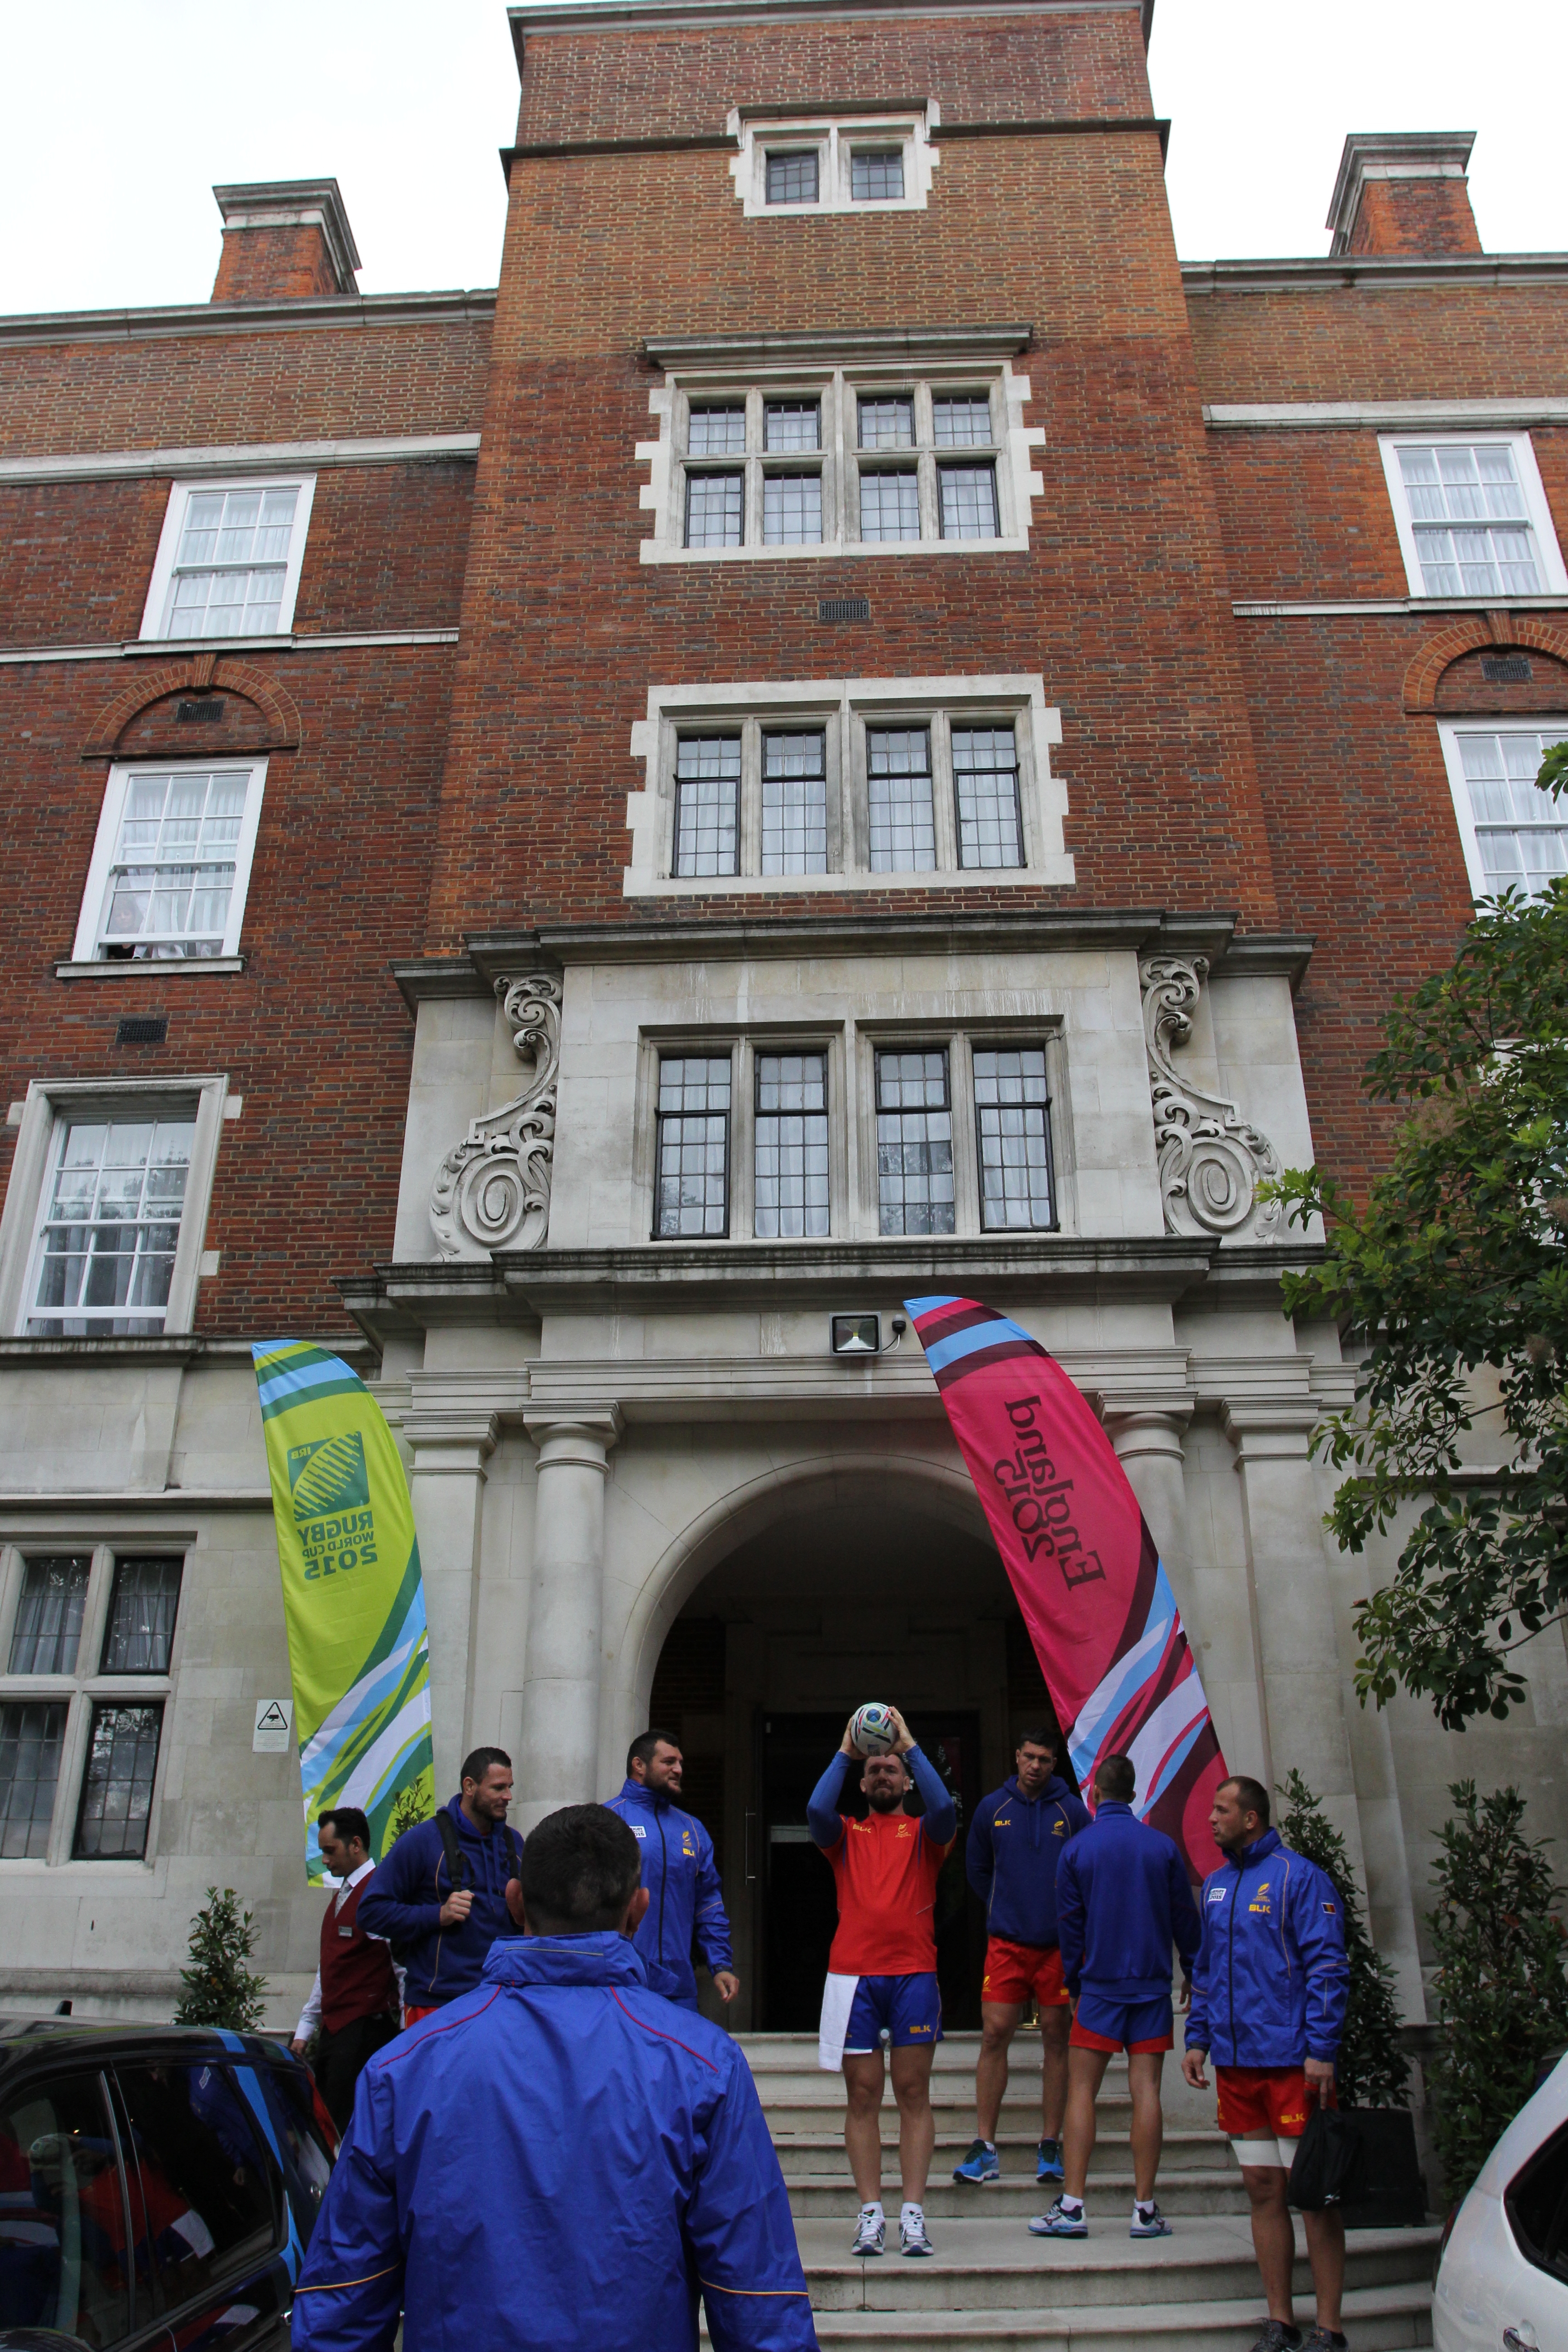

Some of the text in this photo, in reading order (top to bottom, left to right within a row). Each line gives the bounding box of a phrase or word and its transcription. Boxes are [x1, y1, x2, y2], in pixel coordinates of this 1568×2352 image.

[853, 1824, 871, 1833] BLK
[1249, 1904, 1270, 1913] BLK
[909, 2025, 931, 2034] BLK
[1281, 2113, 1305, 2124] BLK
